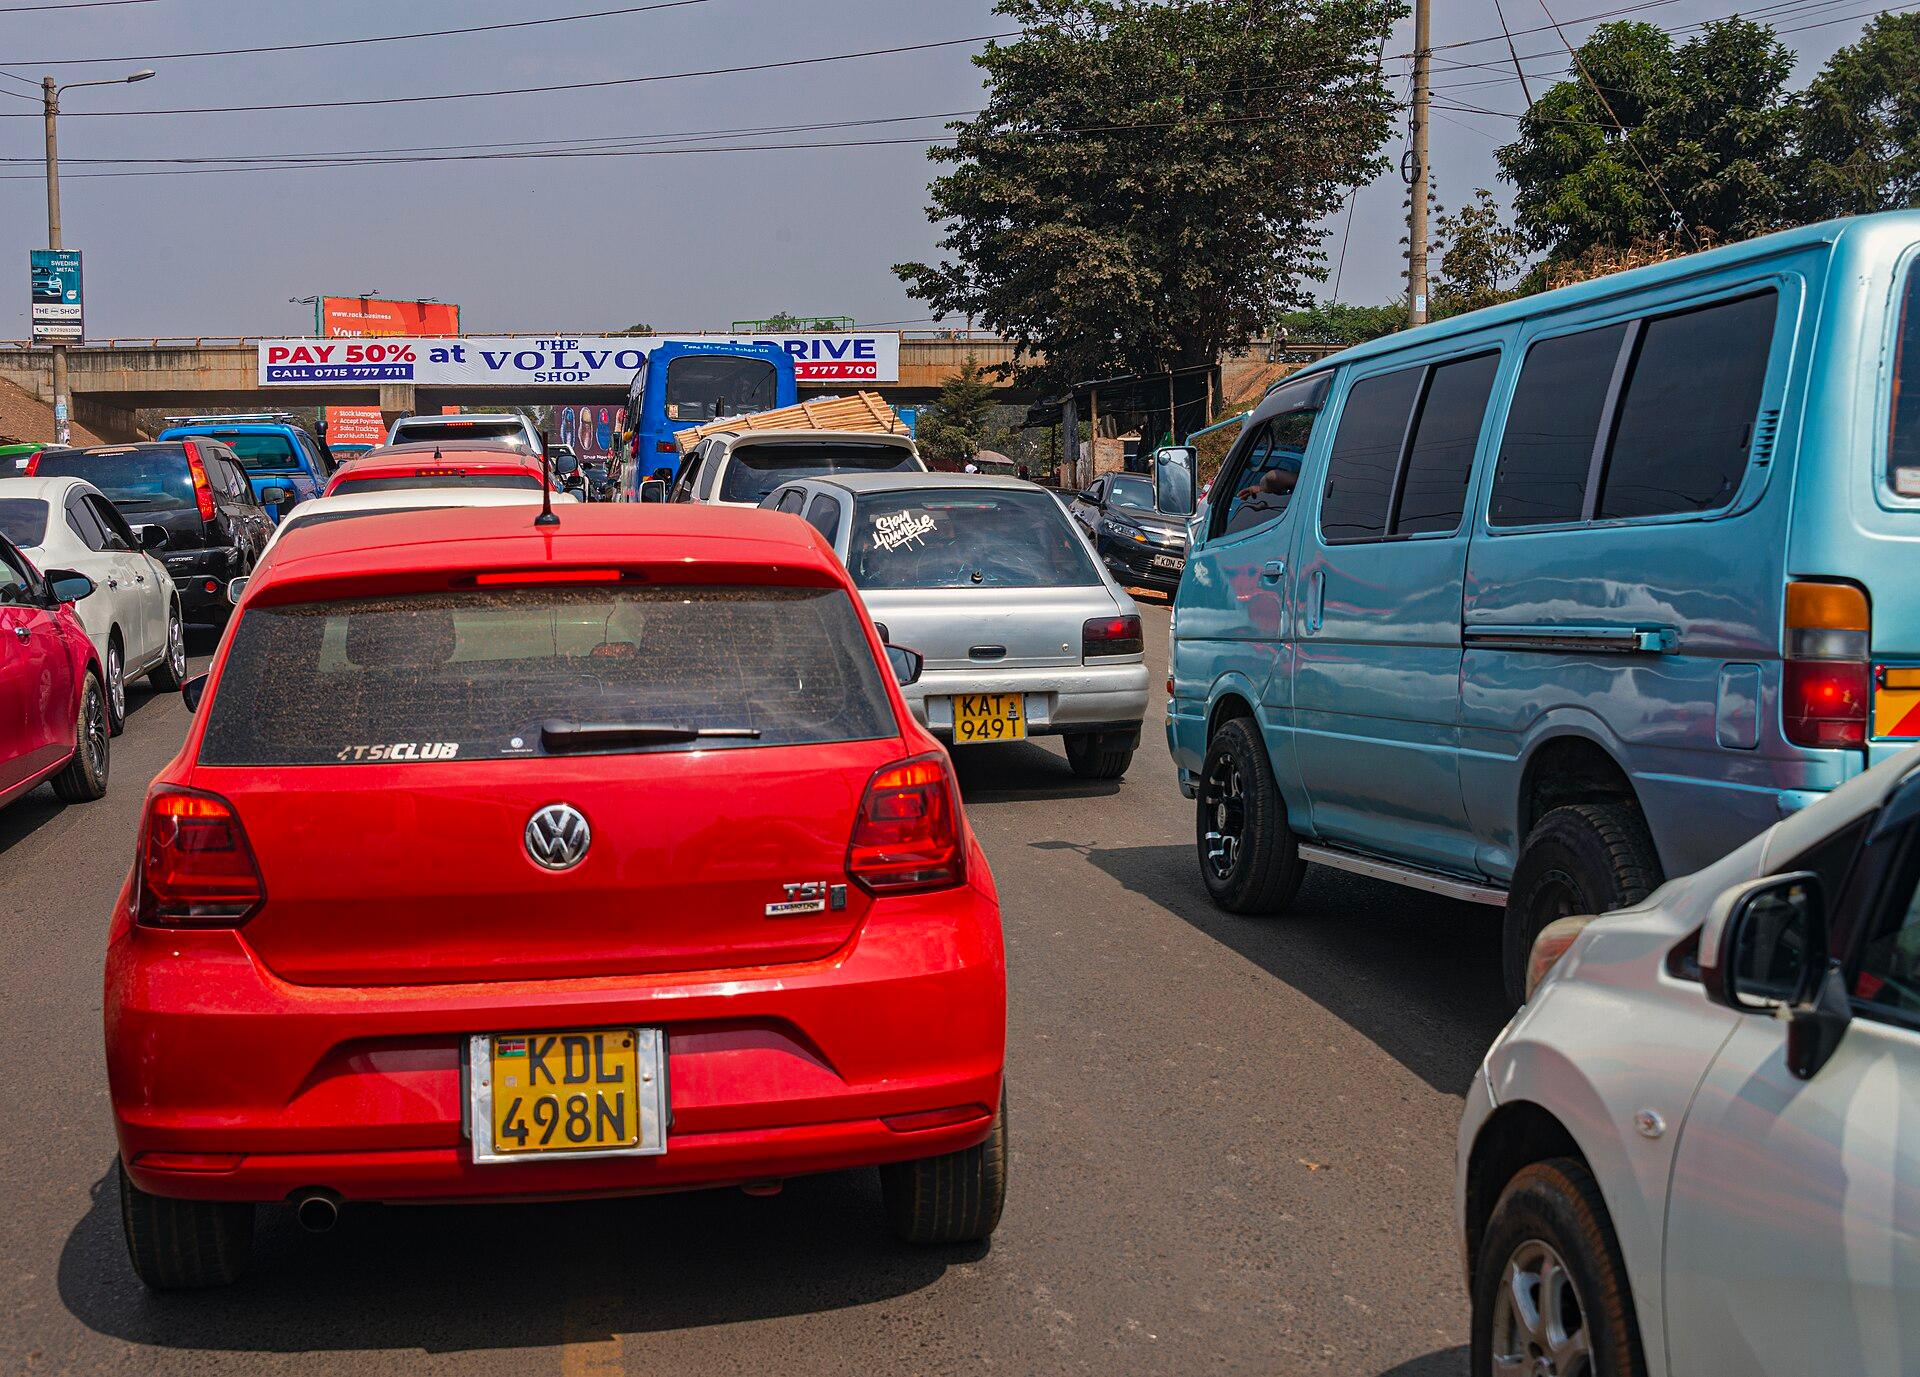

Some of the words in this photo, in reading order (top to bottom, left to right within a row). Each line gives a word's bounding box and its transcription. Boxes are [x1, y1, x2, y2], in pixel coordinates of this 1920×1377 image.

[332, 311, 392, 320] www.rock.business
[268, 345, 335, 364] PAY
[345, 344, 417, 363] 50%
[429, 345, 466, 363] at
[535, 340, 579, 350] THE
[753, 340, 875, 359] RIVE
[479, 350, 647, 370] VOLVO
[809, 366, 838, 375] 777
[844, 365, 876, 374] 700
[272, 369, 309, 378] CALL
[314, 368, 348, 377] 0715
[353, 367, 379, 377] 777
[385, 367, 406, 376] 711
[534, 371, 590, 382] SHOP
[876, 510, 912, 533] Stay
[962, 694, 1005, 717] KAT
[961, 717, 1020, 740] 949T
[528, 1035, 623, 1086] KDL
[502, 1091, 625, 1146] 498N
